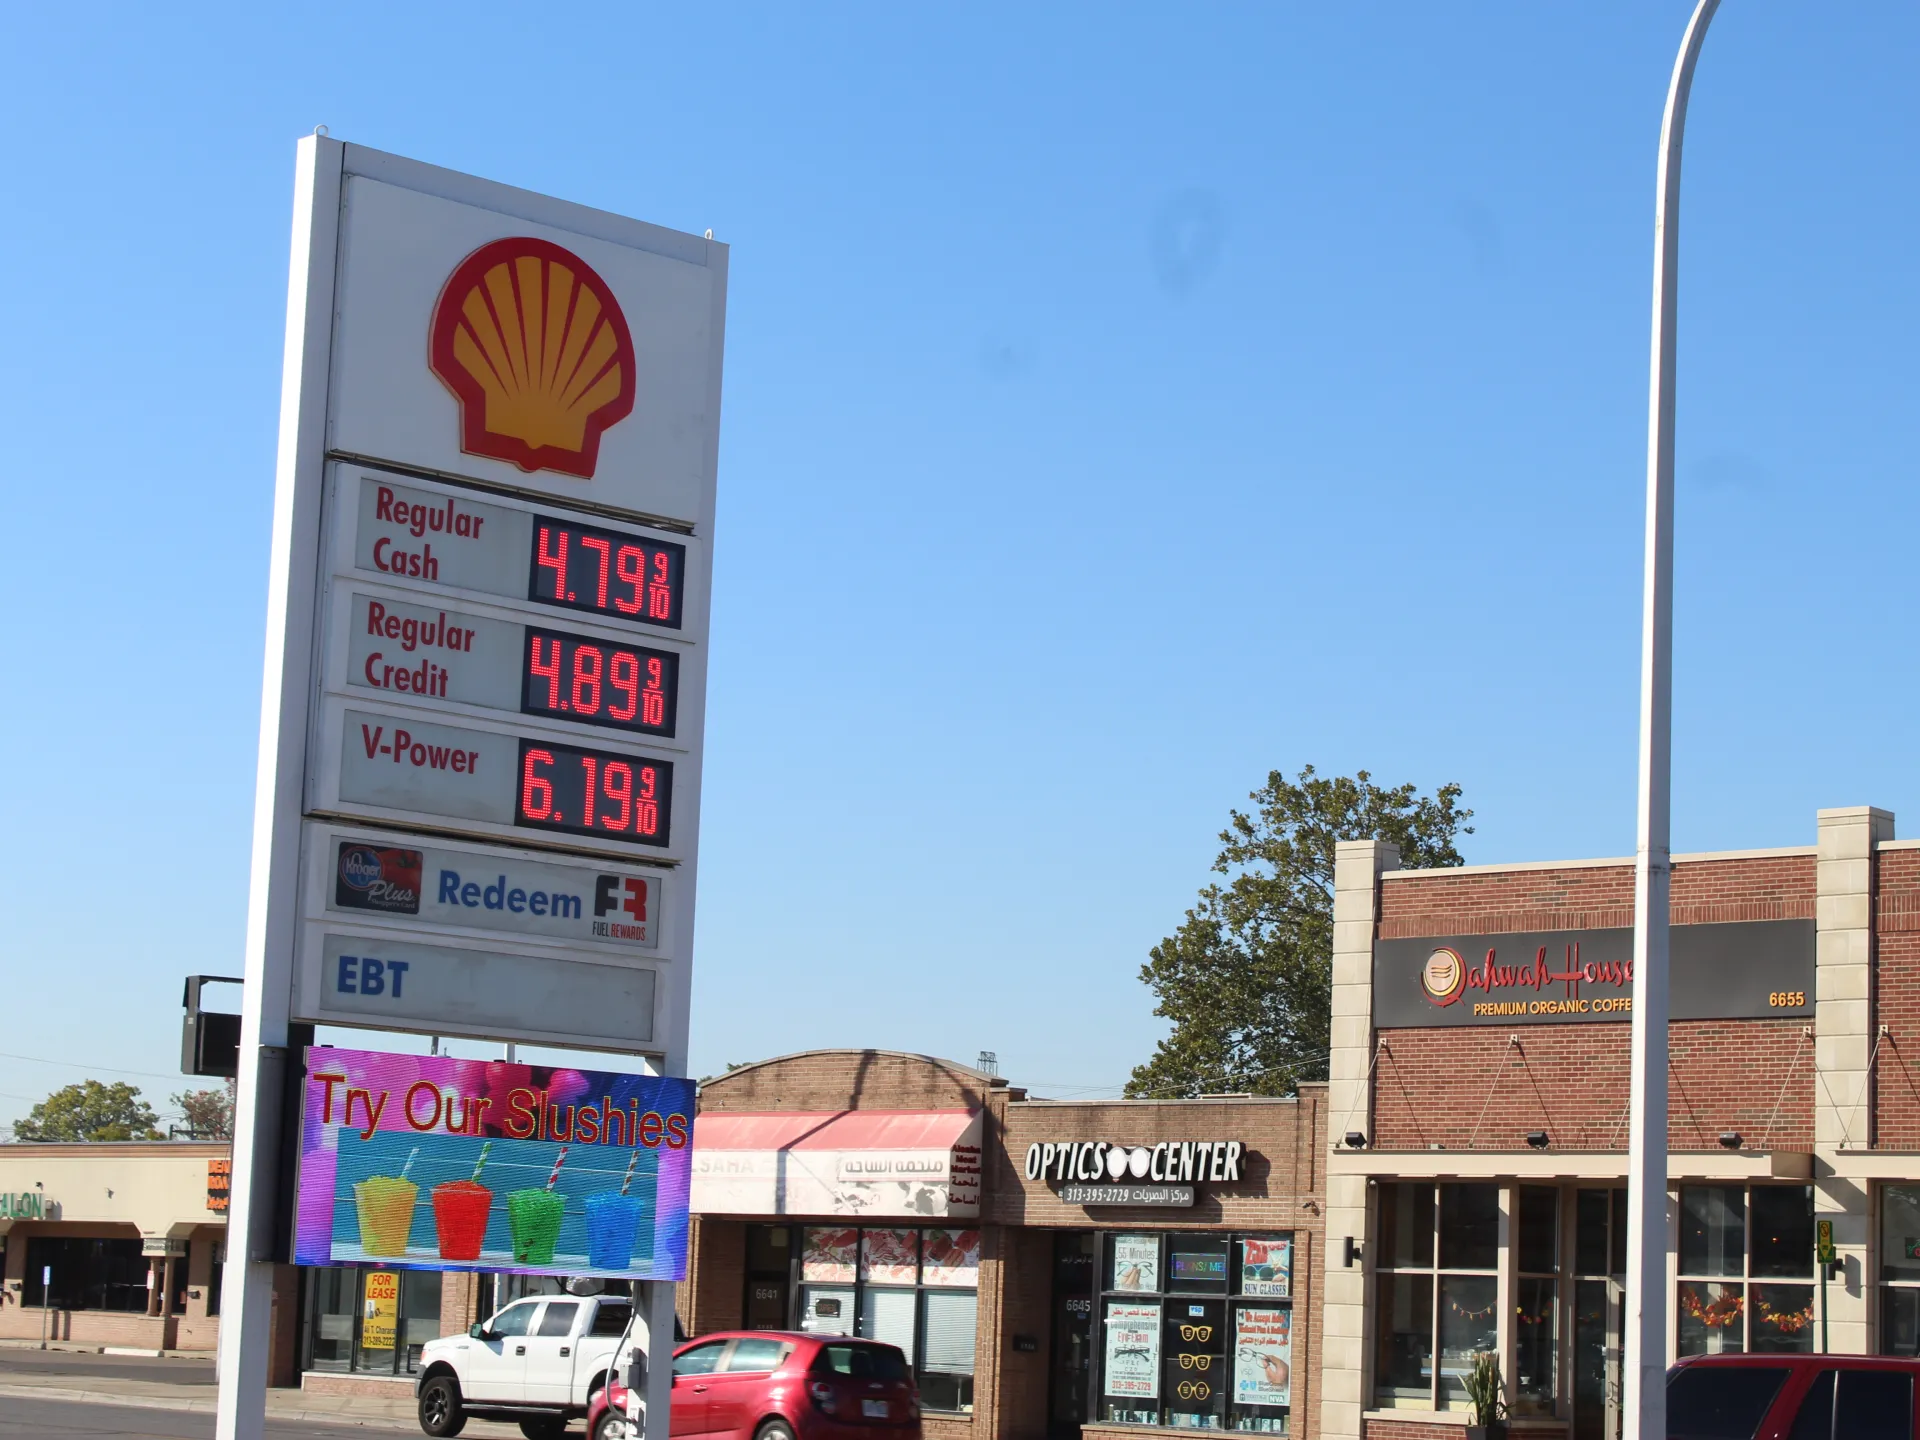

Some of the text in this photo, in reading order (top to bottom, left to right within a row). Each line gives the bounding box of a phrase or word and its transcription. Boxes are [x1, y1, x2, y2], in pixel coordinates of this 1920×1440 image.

[376, 487, 484, 539] Regular
[373, 538, 438, 581] Cash
[538, 527, 645, 614] 4.79
[367, 601, 475, 652] Regular
[365, 653, 448, 697] Credit
[530, 637, 639, 722] 4.89
[361, 724, 479, 774] V-Power
[521, 749, 632, 831] 6.19
[345, 852, 380, 884] Kroger
[368, 880, 413, 902] Plus
[438, 869, 582, 919] Redeem
[592, 921, 646, 941] FUEL REWARDS
[337, 955, 409, 998] EBT
[1473, 997, 1633, 1016] PREMIUM ORGANIC COFFE
[1769, 991, 1805, 1007] 6655
[313, 1072, 688, 1150] Try Our Slushies
[692, 1156, 754, 1173] SAHA
[1024, 1141, 1241, 1182] OPTICS CENTER
[1171, 1190, 1190, 1203] مركز
[367, 1287, 397, 1299] LEASE
[372, 1274, 392, 1286] FOR
[1244, 1284, 1287, 1296] SUN GLASSES
[1066, 1299, 1091, 1312] 6645
